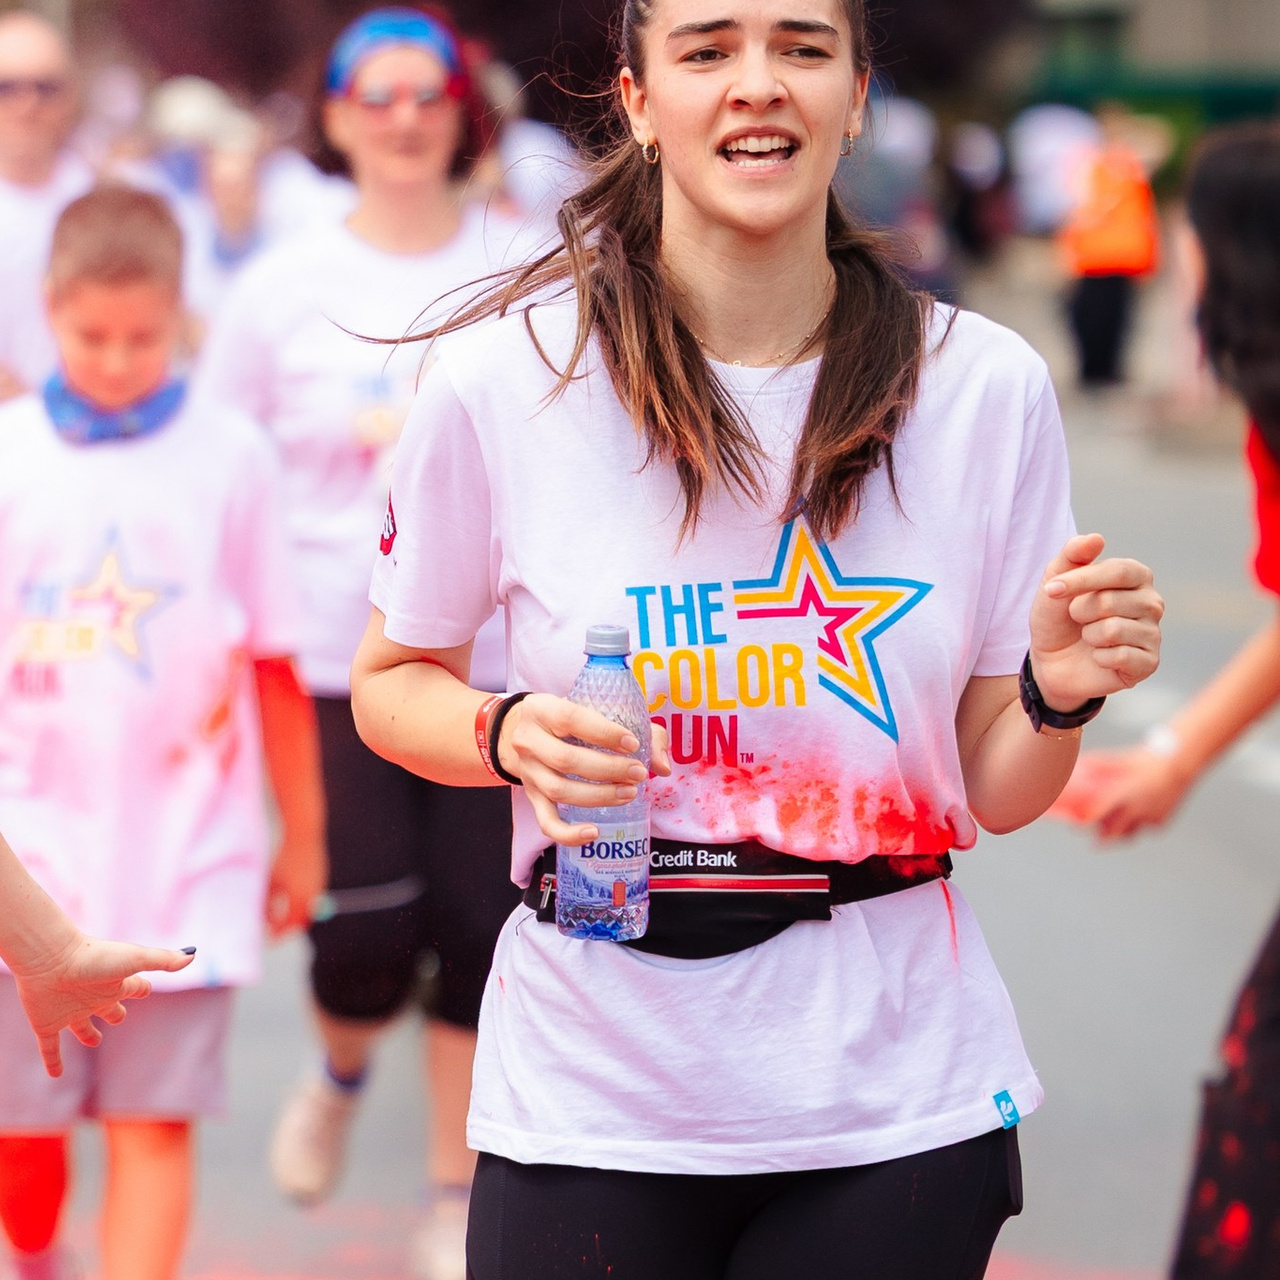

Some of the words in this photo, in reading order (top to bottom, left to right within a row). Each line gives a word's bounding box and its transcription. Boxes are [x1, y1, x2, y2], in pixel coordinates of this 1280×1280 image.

[625, 582, 727, 649] THE
[632, 643, 807, 713] COLOR
[580, 838, 648, 859] BORSEC
[649, 850, 694, 868] Credit
[696, 850, 738, 867] Bank
